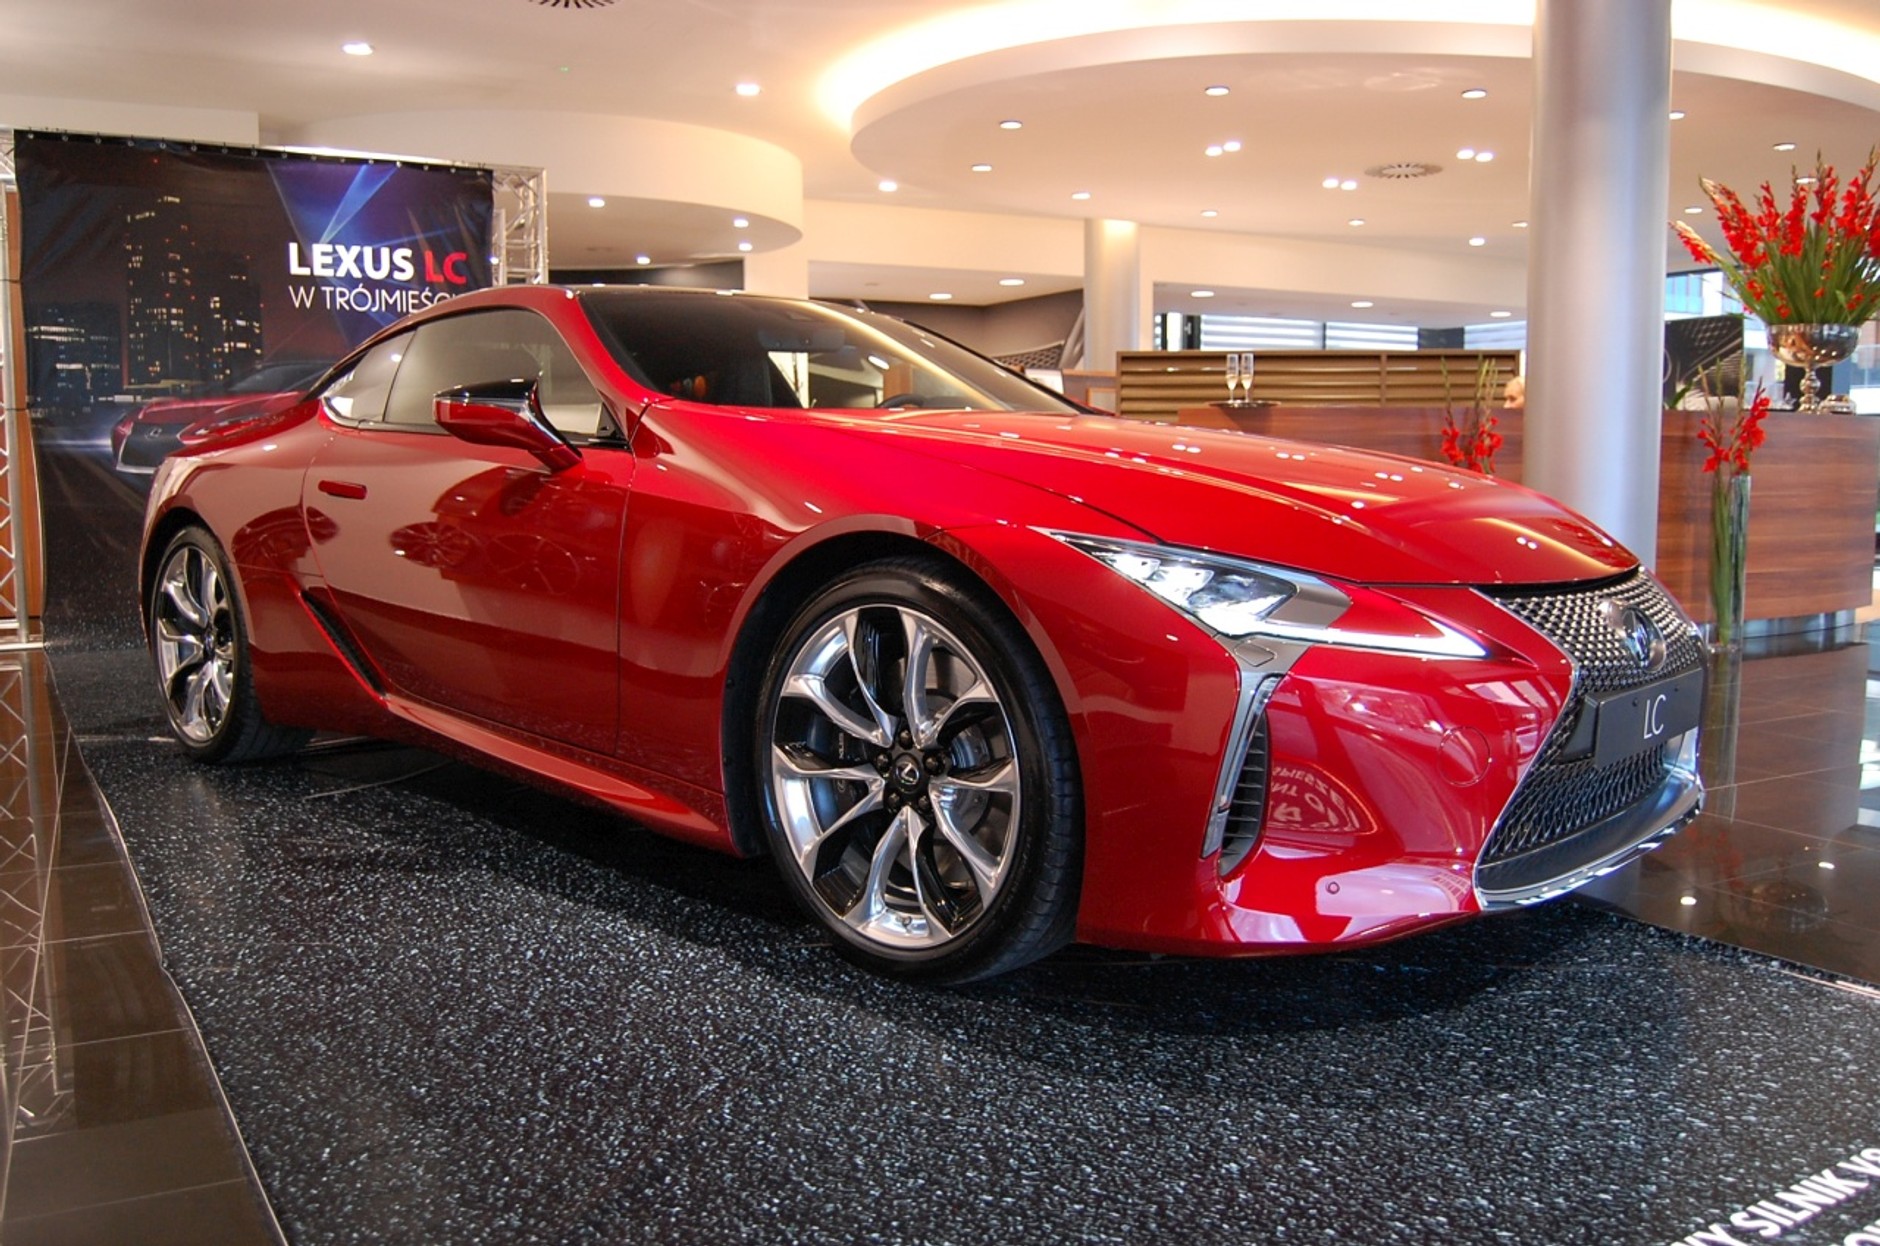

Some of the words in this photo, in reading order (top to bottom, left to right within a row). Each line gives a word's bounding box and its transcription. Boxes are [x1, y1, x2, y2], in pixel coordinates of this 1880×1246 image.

[288, 242, 415, 281] LEXUS
[425, 250, 467, 285] LC
[288, 285, 316, 310] W
[321, 283, 458, 314] TRÓJMIEŚ
[1643, 694, 1667, 739] LC
[1730, 1168, 1870, 1238] SILNIK
